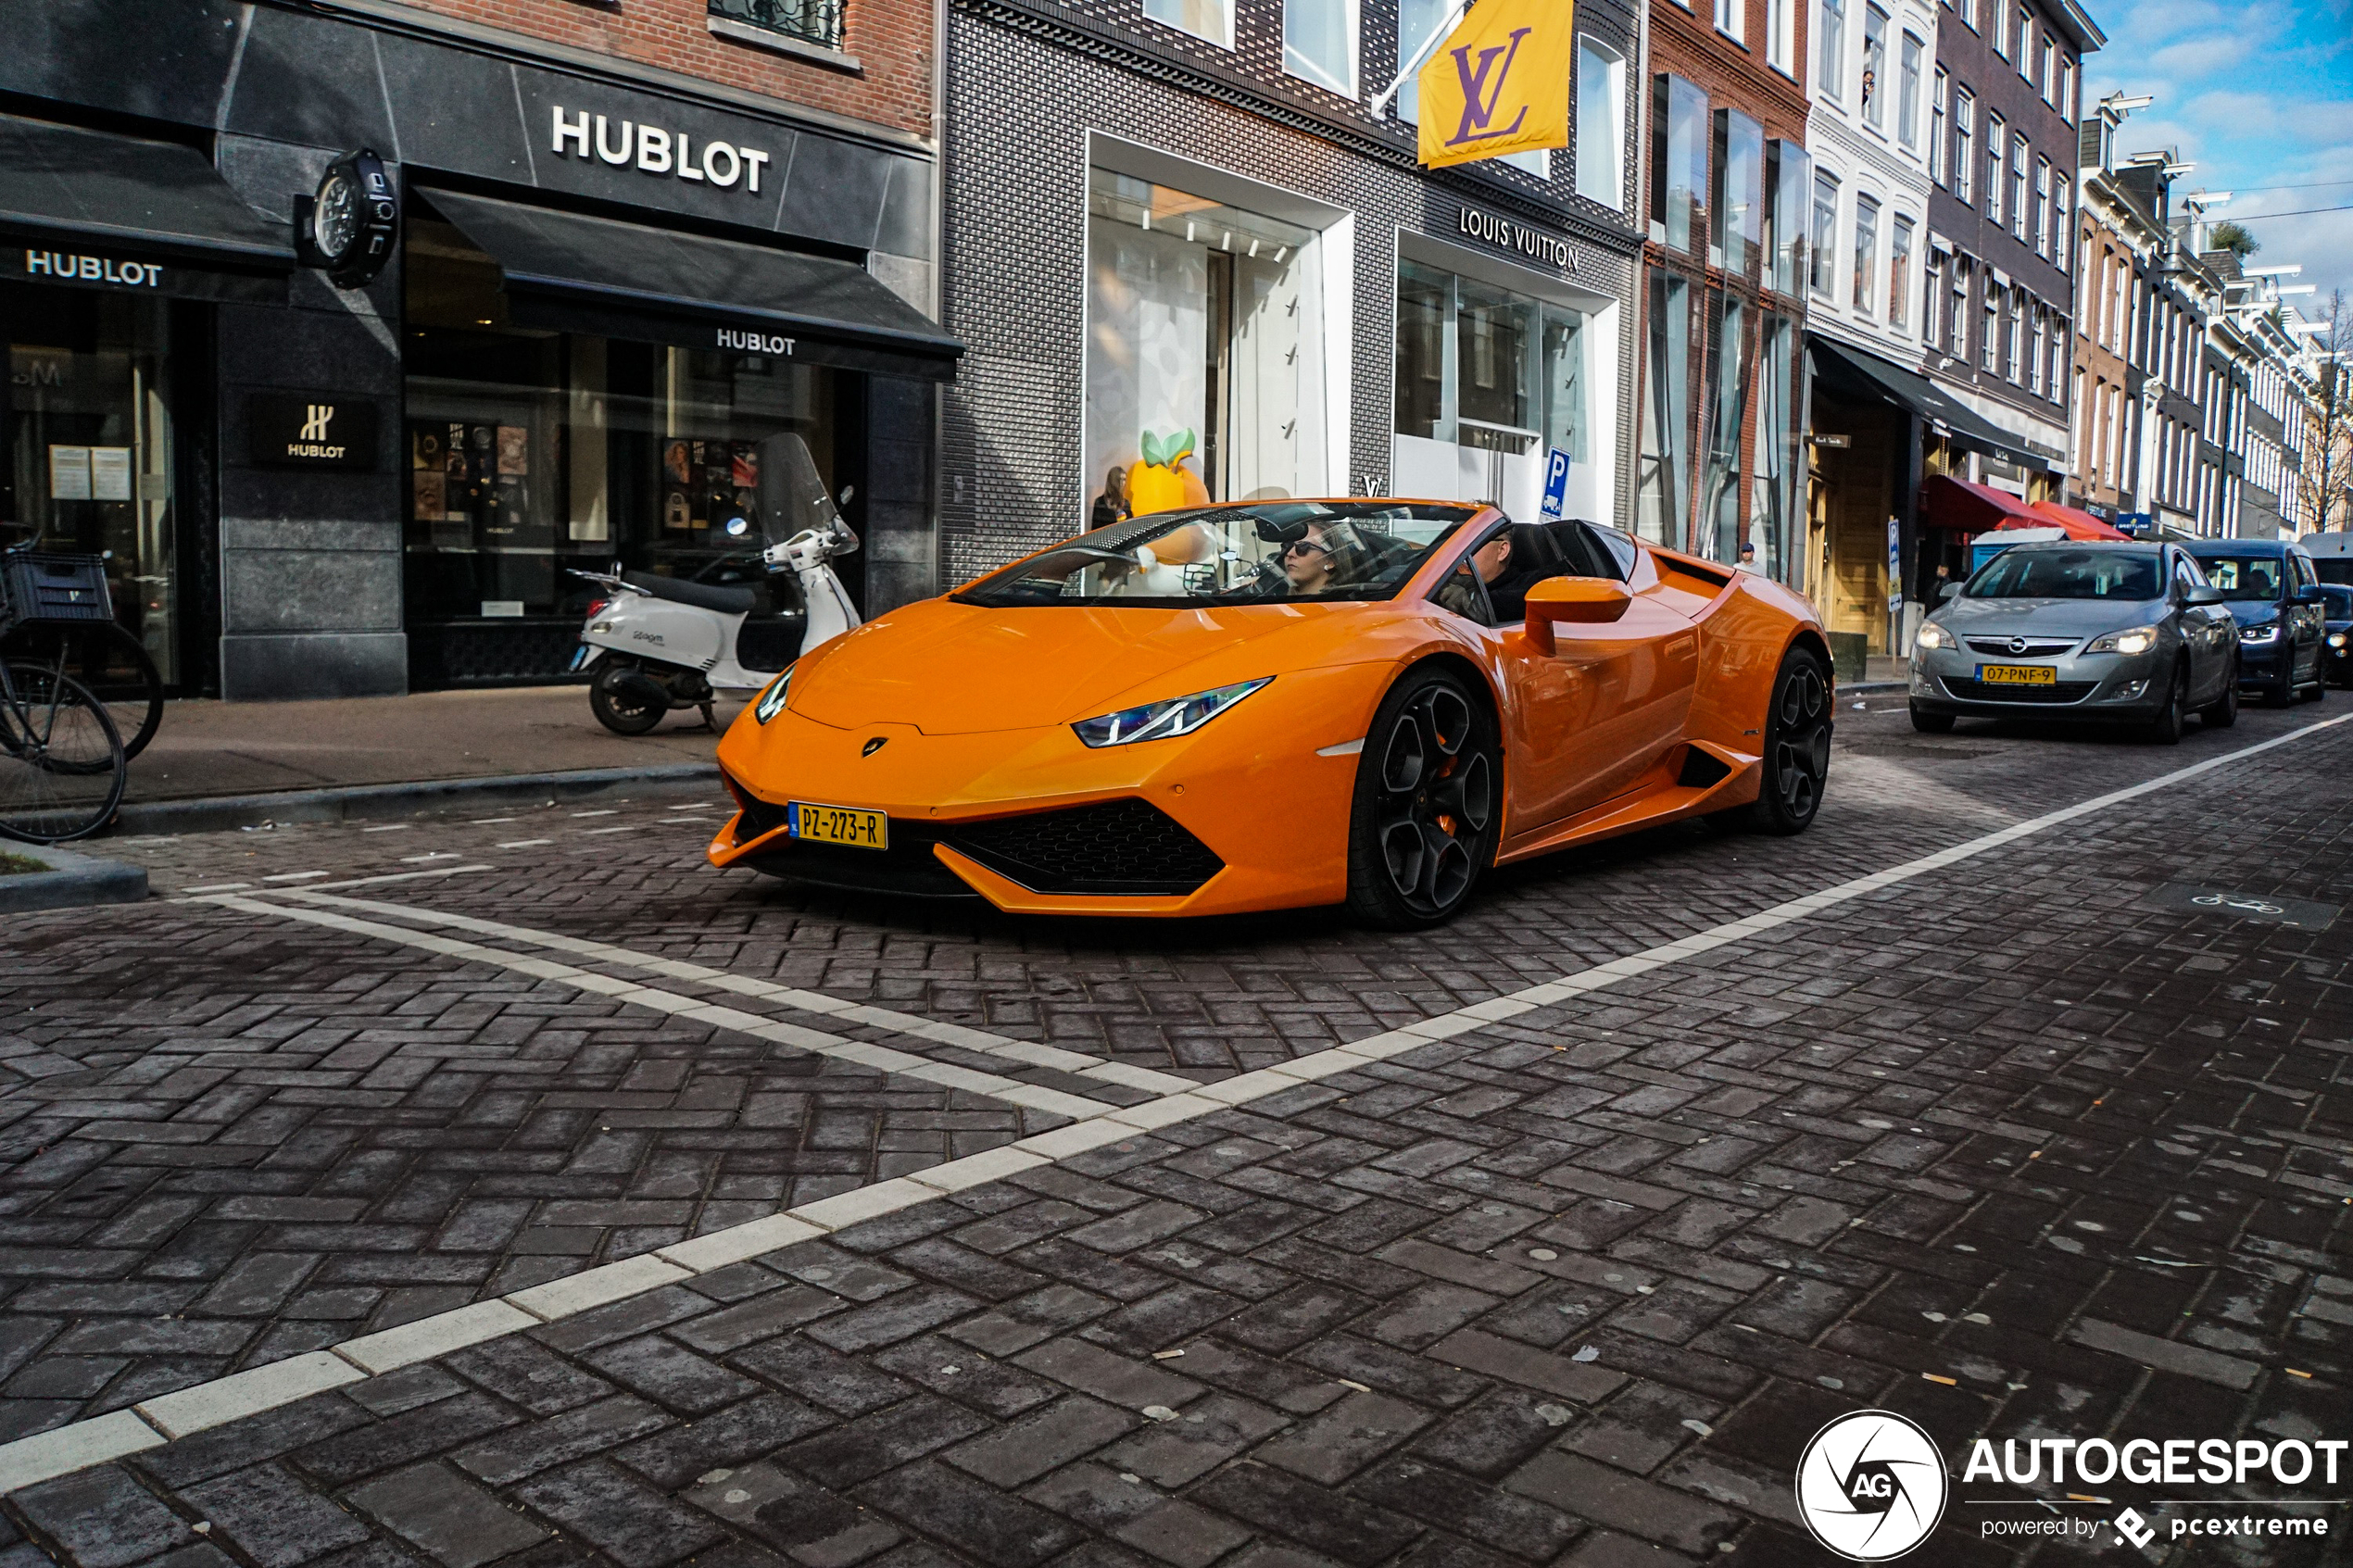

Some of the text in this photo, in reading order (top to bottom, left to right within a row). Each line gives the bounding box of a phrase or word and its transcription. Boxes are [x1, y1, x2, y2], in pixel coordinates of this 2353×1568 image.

[552, 105, 770, 193] HUBLOT
[1460, 207, 1579, 272] LOUIS VUITTON
[26, 249, 163, 287] HUBLOT
[717, 328, 796, 356] HUBLOT
[287, 444, 346, 459] HUBLOT
[1549, 453, 1566, 488] P
[1987, 668, 2051, 682] 07-PNF-9
[802, 808, 877, 844] PZ-273-R
